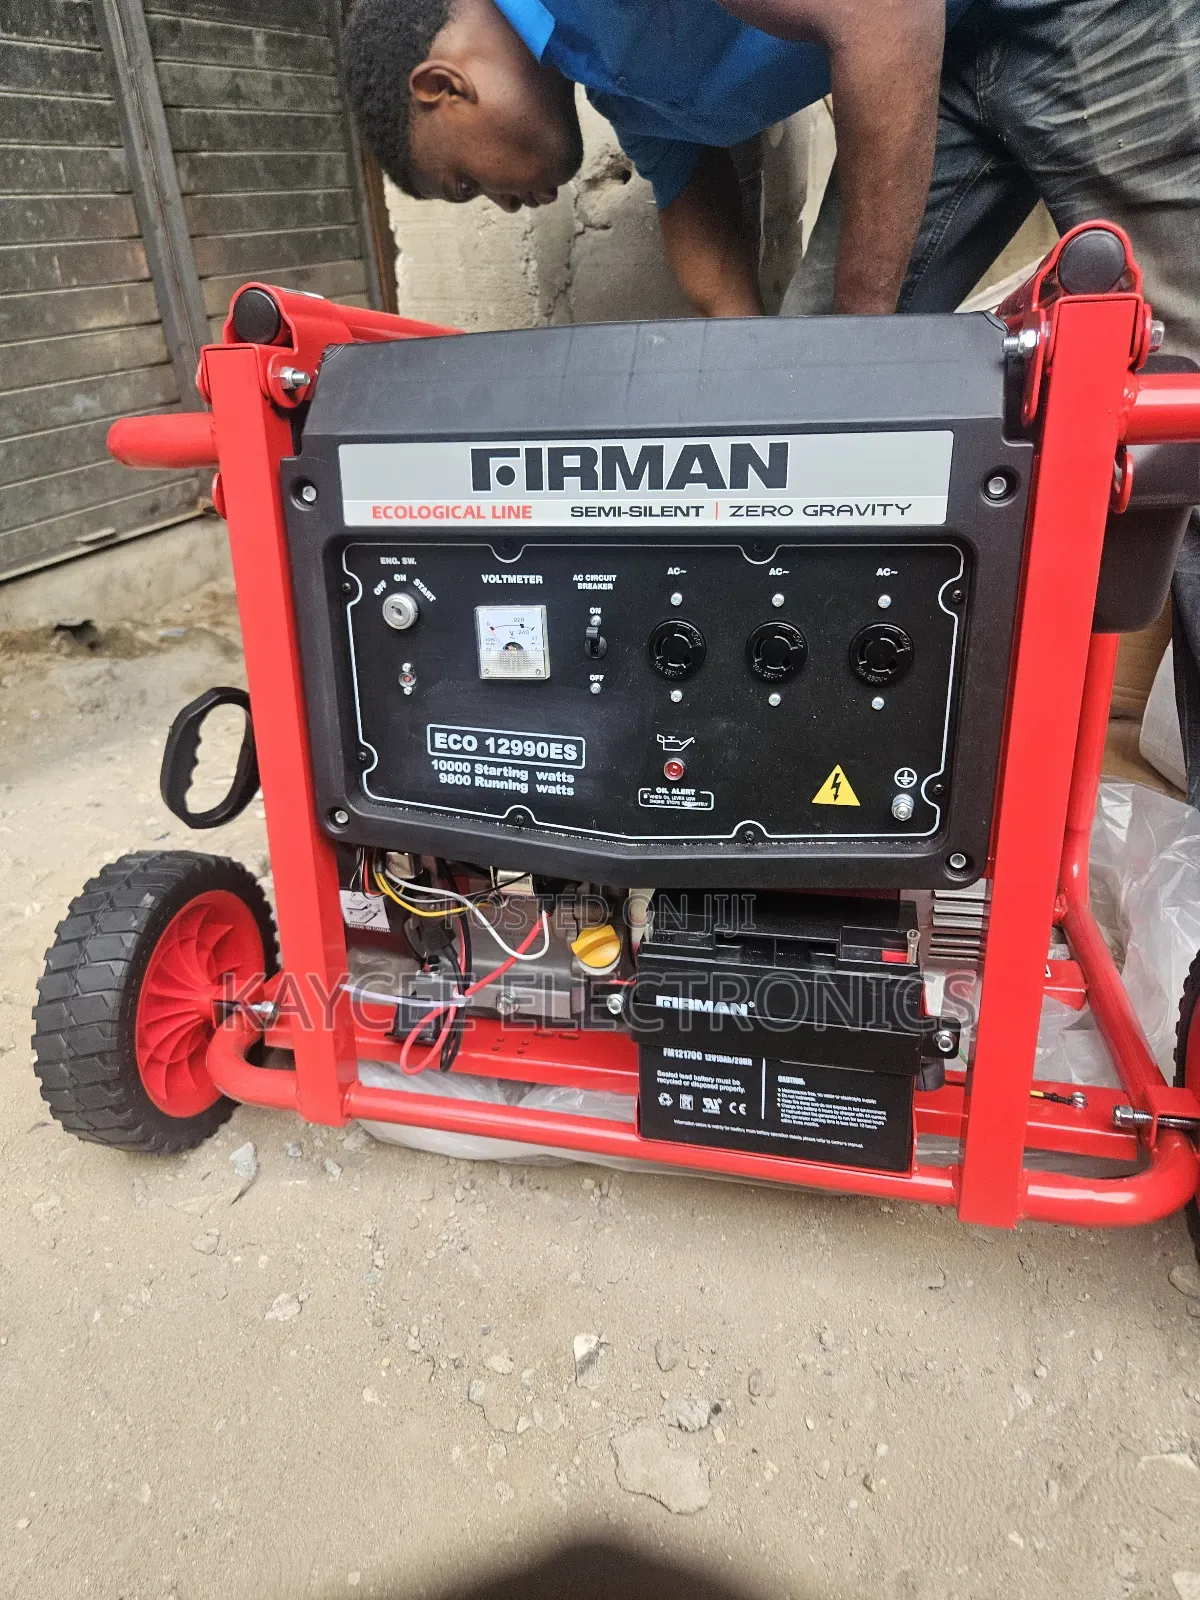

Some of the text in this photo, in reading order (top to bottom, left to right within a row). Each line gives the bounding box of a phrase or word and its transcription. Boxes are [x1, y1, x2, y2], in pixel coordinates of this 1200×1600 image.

[470, 440, 790, 493] FIRMAN
[372, 505, 532, 520] ECOLOGICAL LINE
[570, 505, 704, 518] SEMI-SILENT
[729, 503, 912, 517] ZERO GRAVITY
[393, 573, 407, 582] ON
[480, 574, 544, 584] VOLTMETER
[572, 574, 617, 582] AC CIRCUIT
[373, 579, 387, 596] OFF
[412, 578, 437, 602] START
[589, 607, 602, 615] ON
[589, 674, 605, 682] OFF
[433, 732, 578, 761] ECO 12990ES
[431, 759, 575, 783] 10000 Starting watts
[439, 772, 575, 796] 9800 Running watts
[655, 786, 696, 796] OIL ALERT
